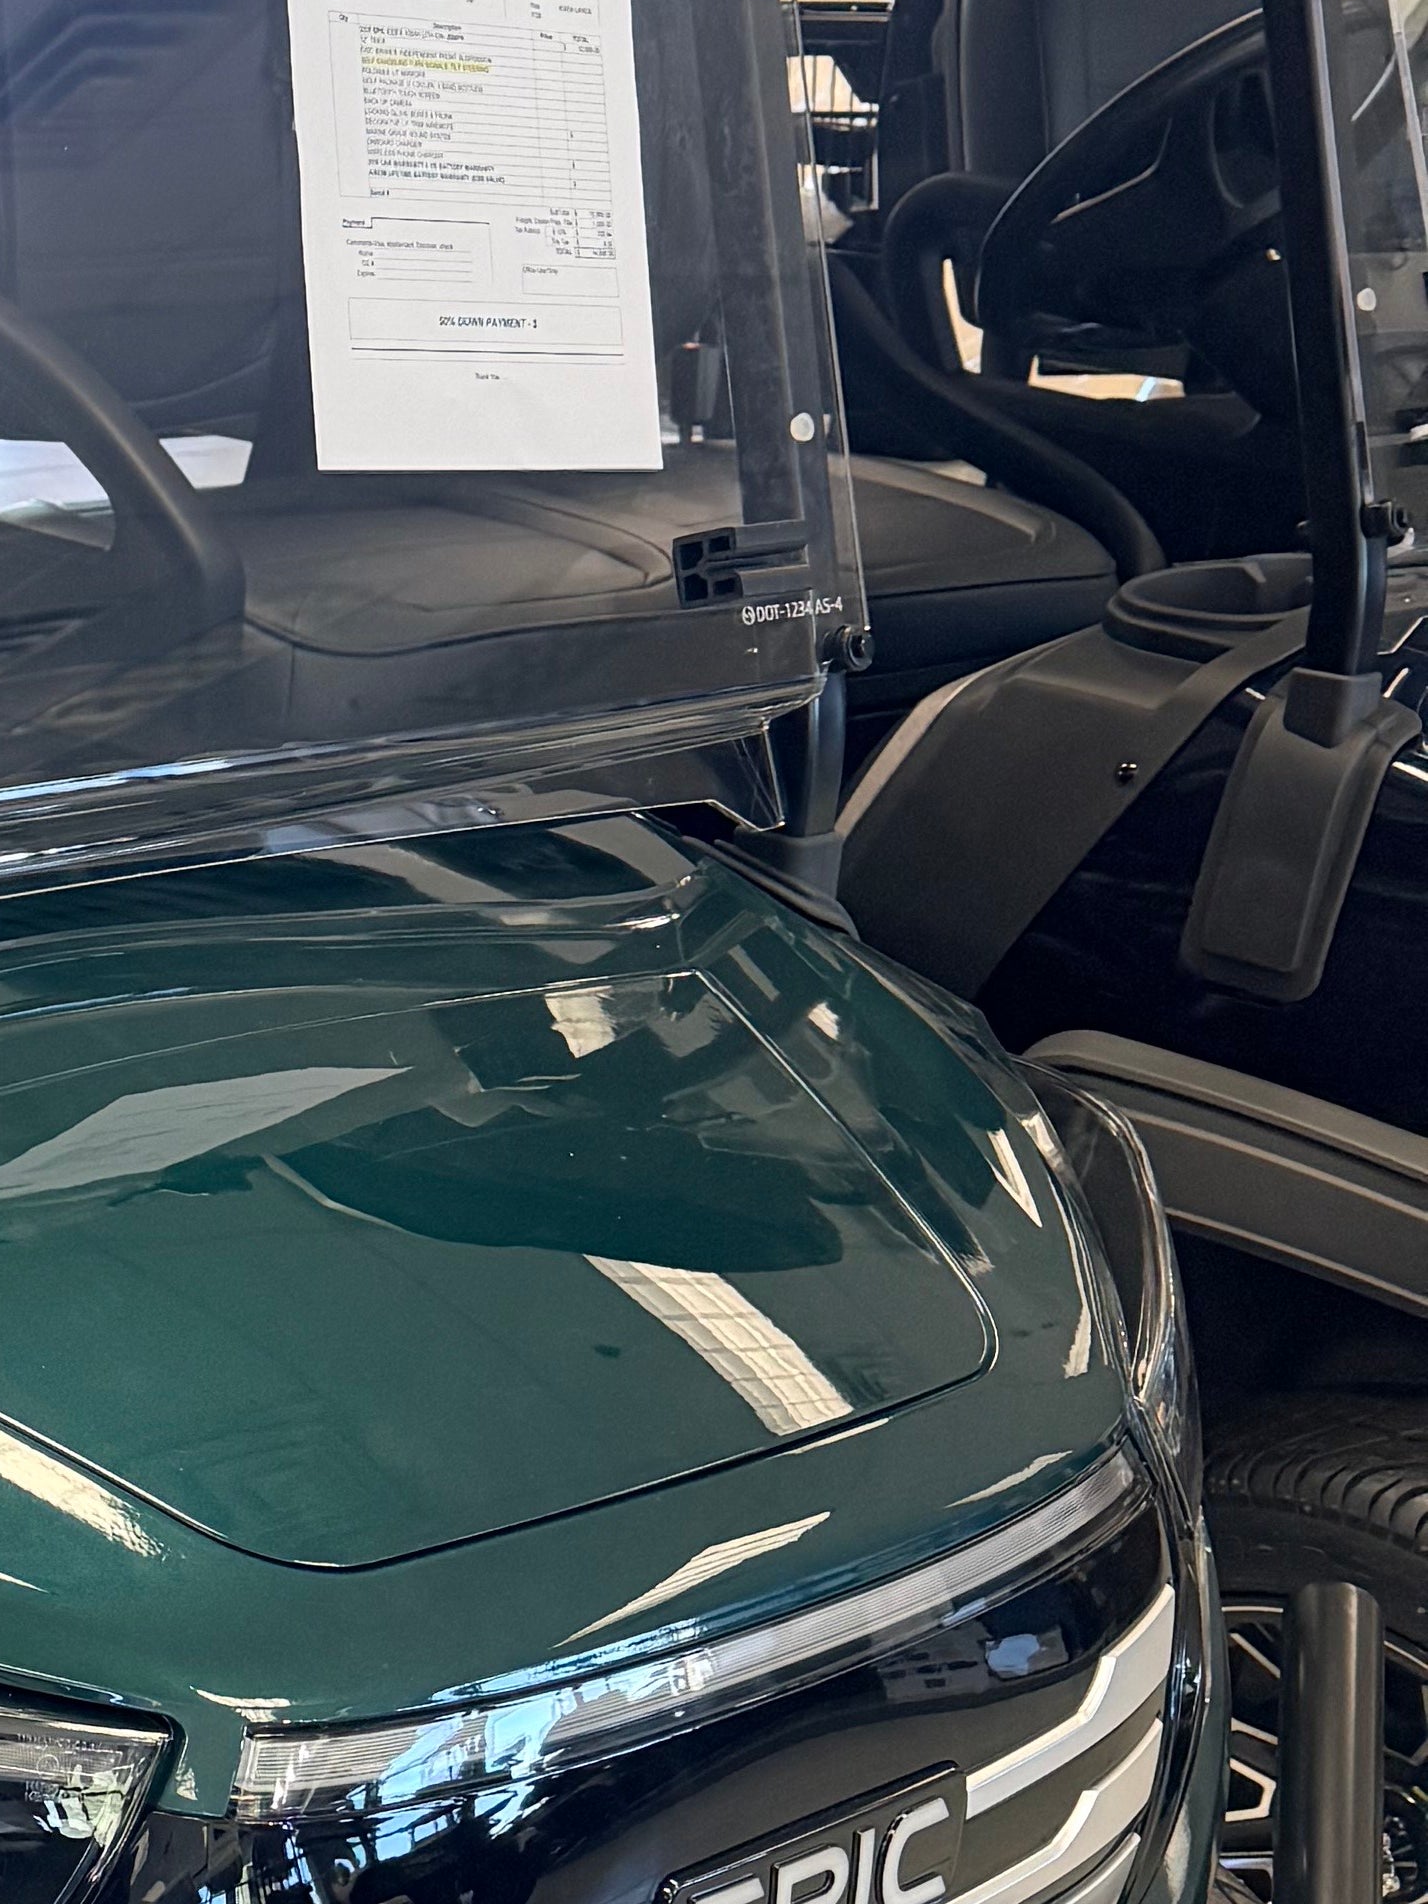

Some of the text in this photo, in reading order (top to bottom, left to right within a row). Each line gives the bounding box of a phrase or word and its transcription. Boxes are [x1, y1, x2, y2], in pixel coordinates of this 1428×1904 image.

[486, 317, 527, 328] PAYMENT
[756, 596, 843, 623] DOT-1234 AS-4
